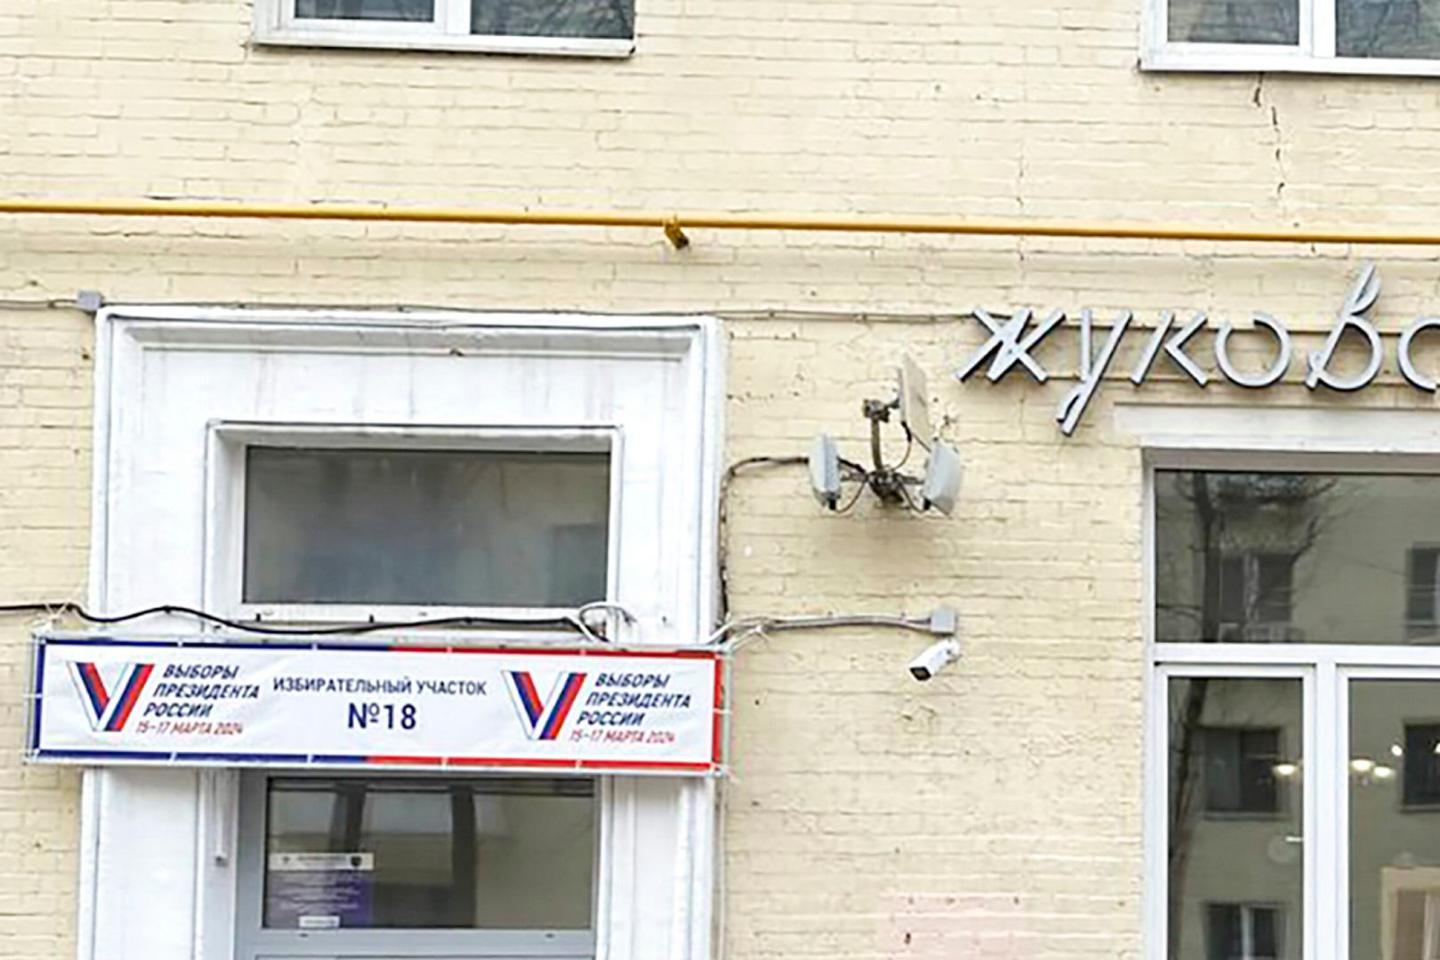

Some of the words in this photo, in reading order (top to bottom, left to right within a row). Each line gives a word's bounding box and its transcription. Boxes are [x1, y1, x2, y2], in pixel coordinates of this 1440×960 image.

[162, 664, 239, 680] ВЫБОРЫ
[273, 676, 412, 694] ИЗБИРАТЕЛЬНЫЙ
[416, 679, 488, 696] УЧАСТОК
[595, 673, 671, 688] ВЫБОРЫ
[152, 683, 260, 700] ПРЕЗИДЕНТА
[585, 691, 692, 708] ПРЕЗИДЕНТА
[143, 702, 214, 718] РОССИИ
[348, 702, 417, 729] №18
[576, 711, 646, 727] РОССИИ
[170, 721, 212, 735] МАРТА
[213, 722, 244, 736] 2024
[603, 730, 645, 743] МАРТА
[645, 731, 677, 744] 2024
